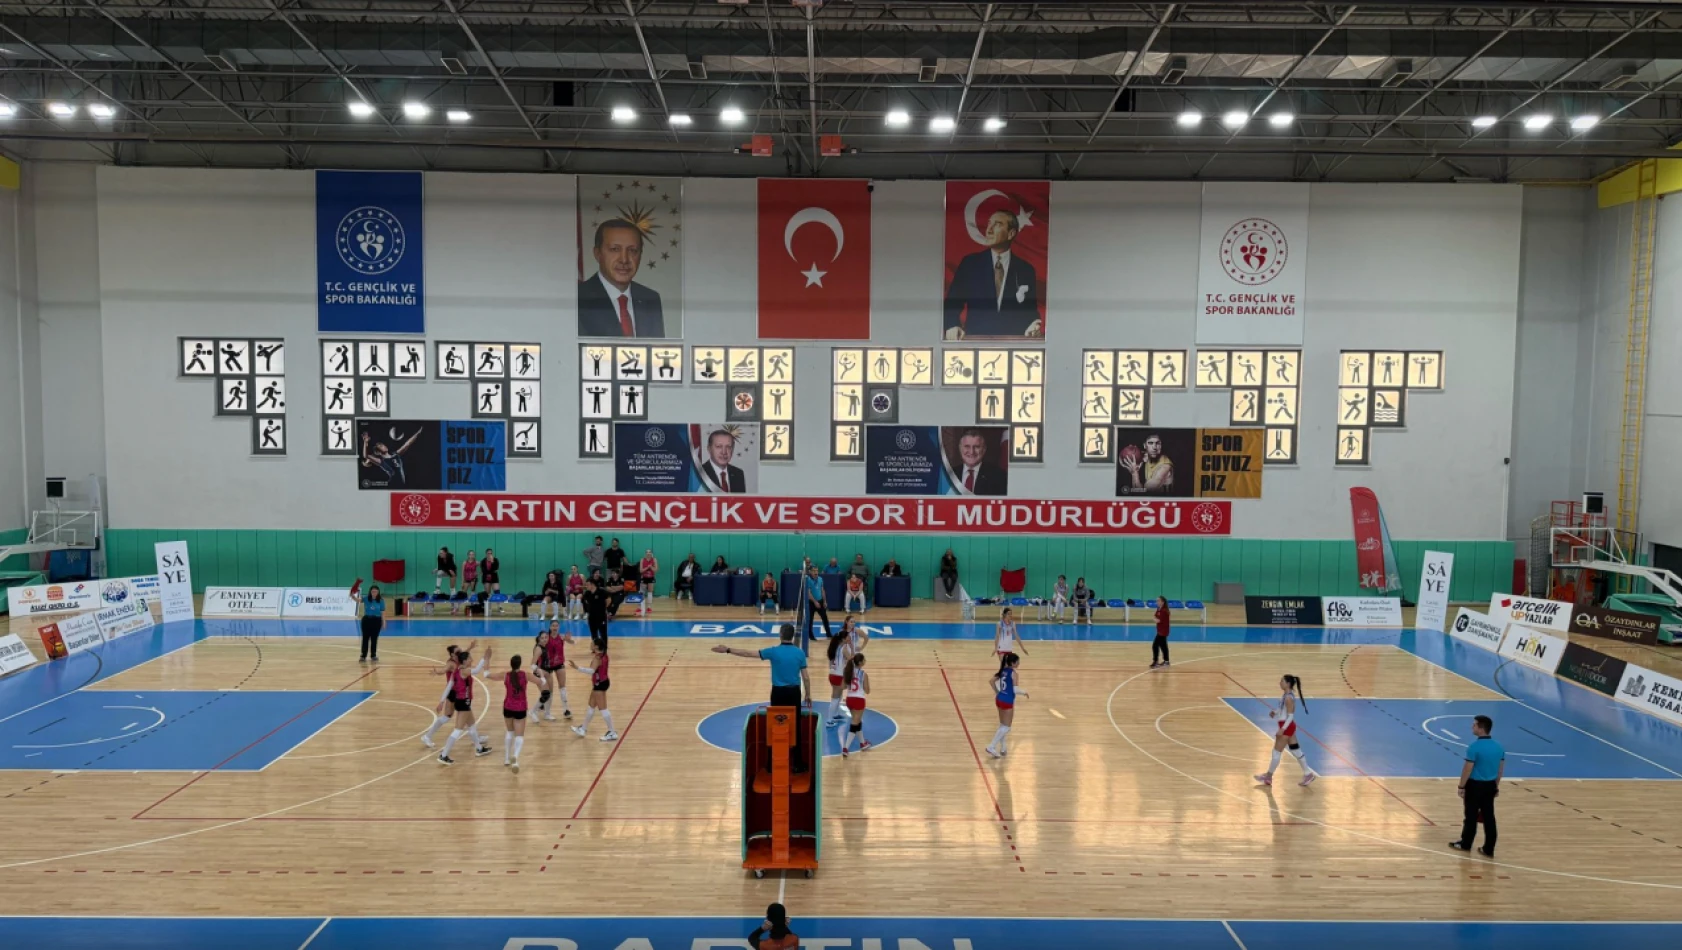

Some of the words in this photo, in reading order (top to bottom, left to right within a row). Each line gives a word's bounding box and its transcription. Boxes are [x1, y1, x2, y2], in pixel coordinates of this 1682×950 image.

[325, 281, 345, 292] T.C.
[348, 281, 398, 294] GENÇLİK
[401, 283, 416, 294] VE
[325, 294, 354, 305] SPOR
[356, 294, 416, 306] BAKANLIĞI
[1205, 293, 1226, 303] T.C.
[1229, 293, 1278, 305] GENÇLİK
[1281, 294, 1295, 304] VE
[1205, 305, 1234, 315] SPOR
[1237, 305, 1295, 316] BAKANLIĞI
[447, 427, 485, 445] SPOR
[1202, 434, 1243, 452] SPOR
[447, 447, 495, 465] CUYUZ
[1201, 455, 1252, 472] CUYUZ
[444, 499, 576, 523] BARTIN
[588, 496, 745, 527] GENÇLİK
[753, 502, 799, 524] VE
[809, 502, 905, 526] SPOR
[916, 499, 946, 526] İL
[956, 499, 1181, 530] MÜDÜRLÜĞÜ
[162, 550, 185, 568] SÂ
[163, 570, 187, 584] YE
[1427, 561, 1446, 578] SÂ
[1425, 578, 1446, 594] YE
[219, 591, 267, 600] EMNİYET
[228, 601, 256, 609] OTEL
[1284, 599, 1306, 609] EMLAK
[1604, 614, 1657, 630] ÖZAYDINLAR
[1613, 627, 1643, 639] İNŞAAT
